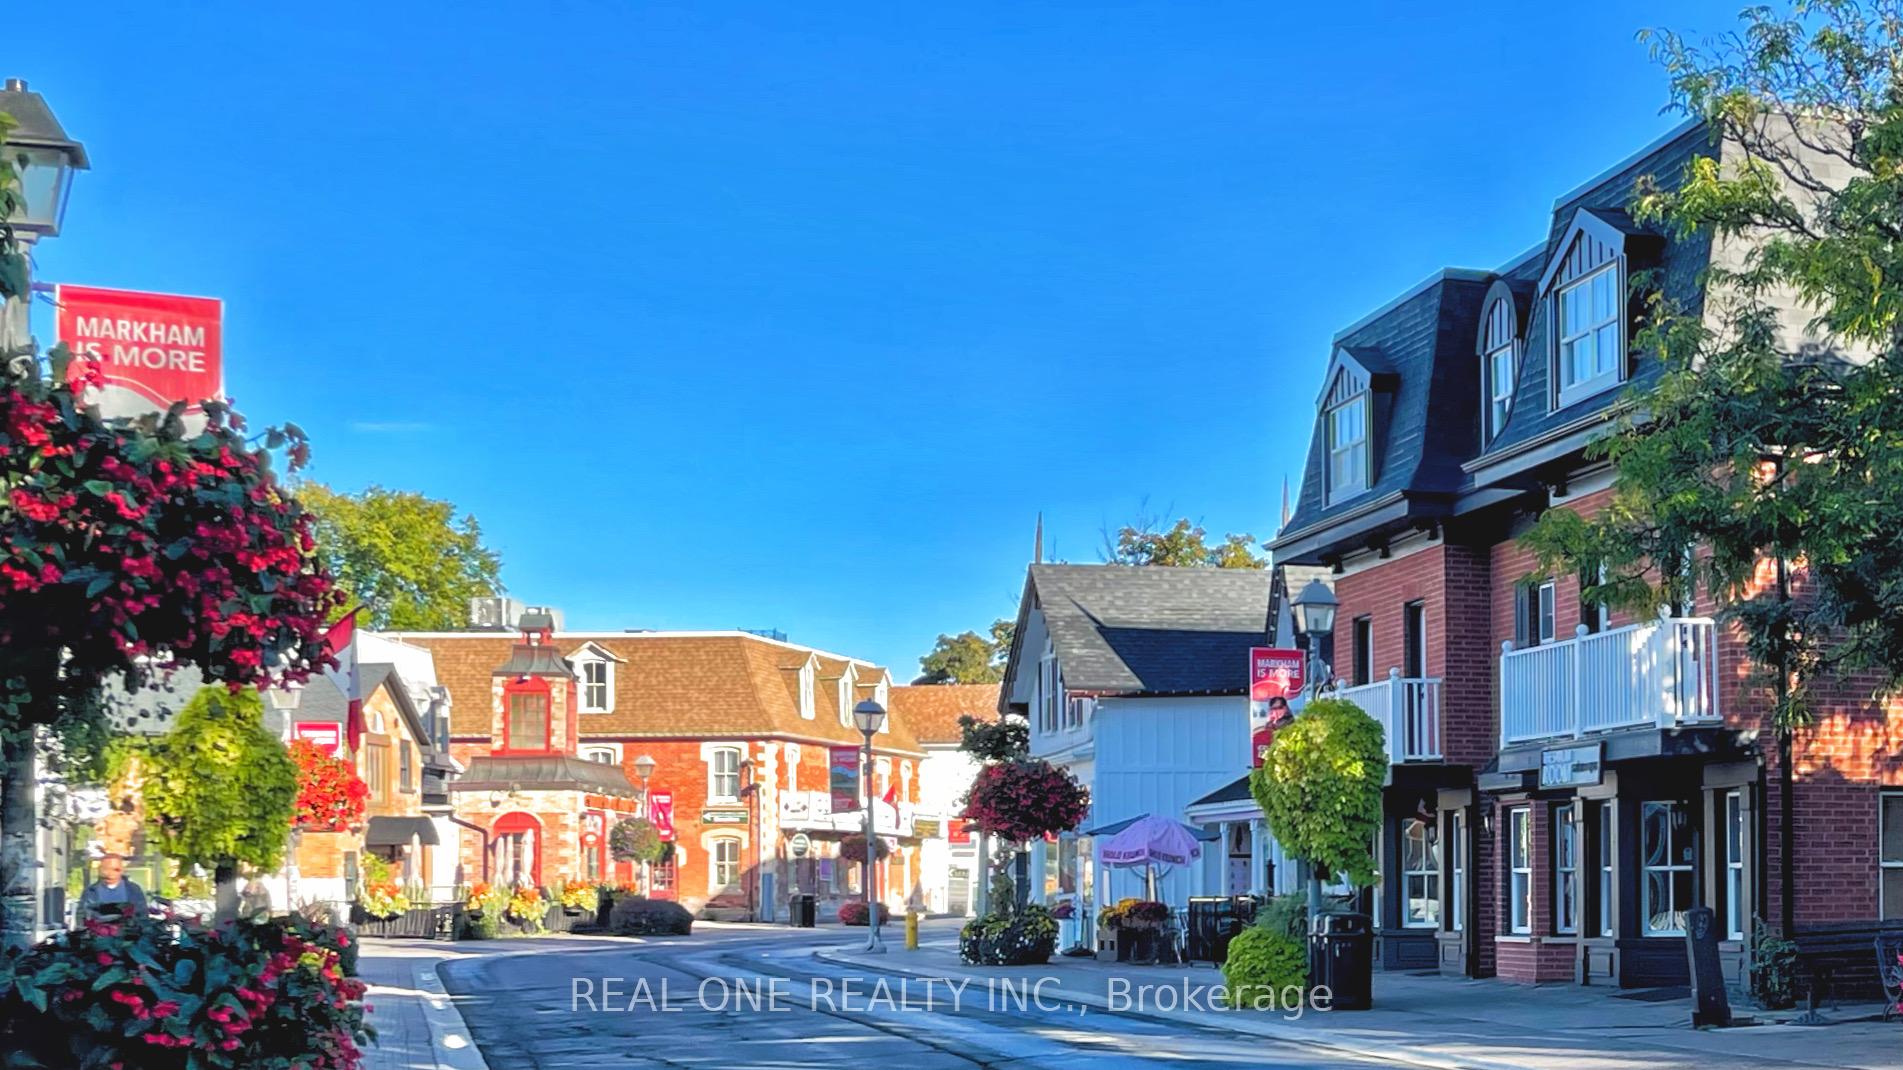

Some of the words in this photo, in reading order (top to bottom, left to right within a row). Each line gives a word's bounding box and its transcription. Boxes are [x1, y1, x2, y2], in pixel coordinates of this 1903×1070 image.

[76, 316, 205, 347] MARKHAM
[76, 341, 102, 363] IS
[113, 345, 206, 373] MORE
[1257, 668, 1266, 678] IS
[1269, 668, 1300, 679] MORE
